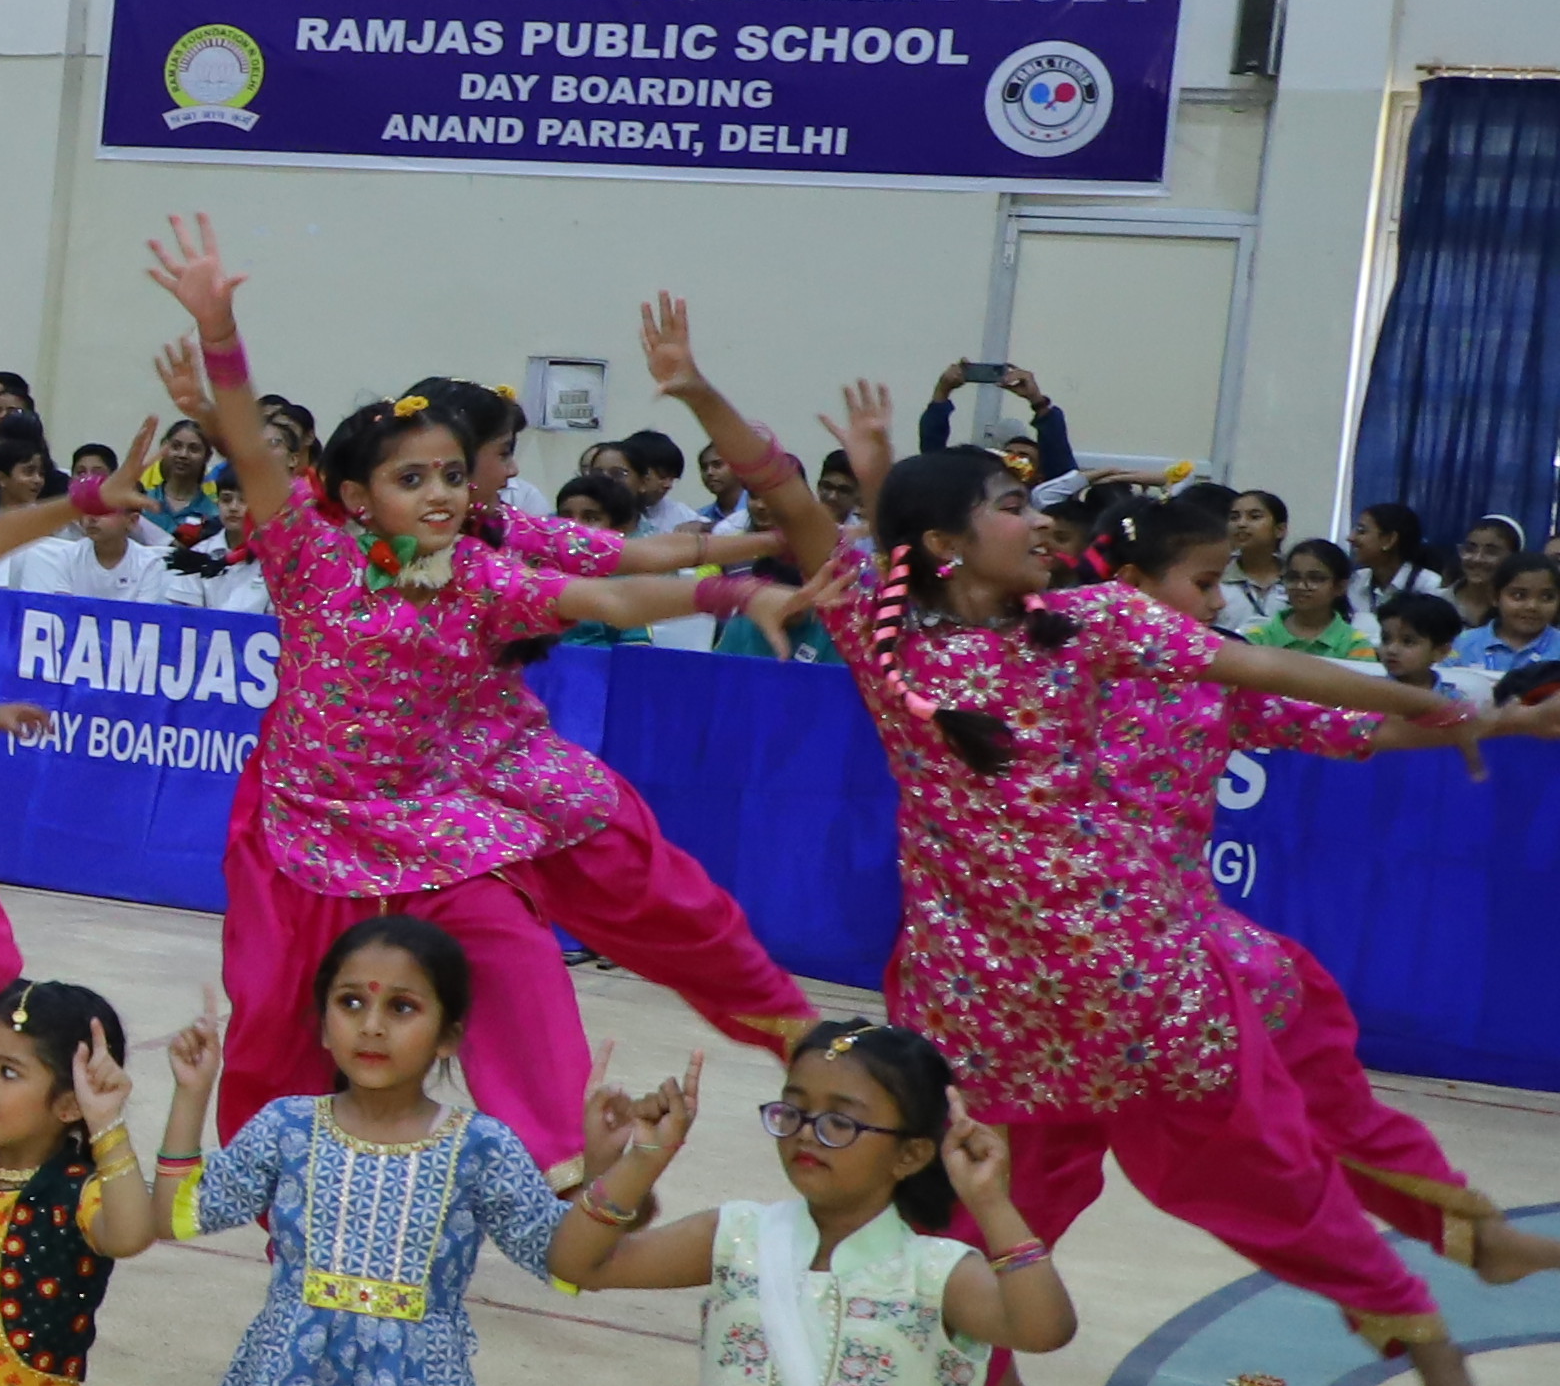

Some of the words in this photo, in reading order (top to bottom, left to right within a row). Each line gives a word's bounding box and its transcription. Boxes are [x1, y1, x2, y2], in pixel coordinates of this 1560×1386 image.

[295, 17, 504, 55] RAMJAS
[521, 21, 718, 60] PUBLIC
[734, 25, 969, 65] SCHOOL
[460, 73, 539, 101] DAY
[551, 75, 773, 108] BOARDING
[381, 114, 524, 144] ANAND
[536, 118, 704, 157] PARBAT,
[720, 124, 848, 156] DELHI
[19, 609, 282, 709] RAMJAS
